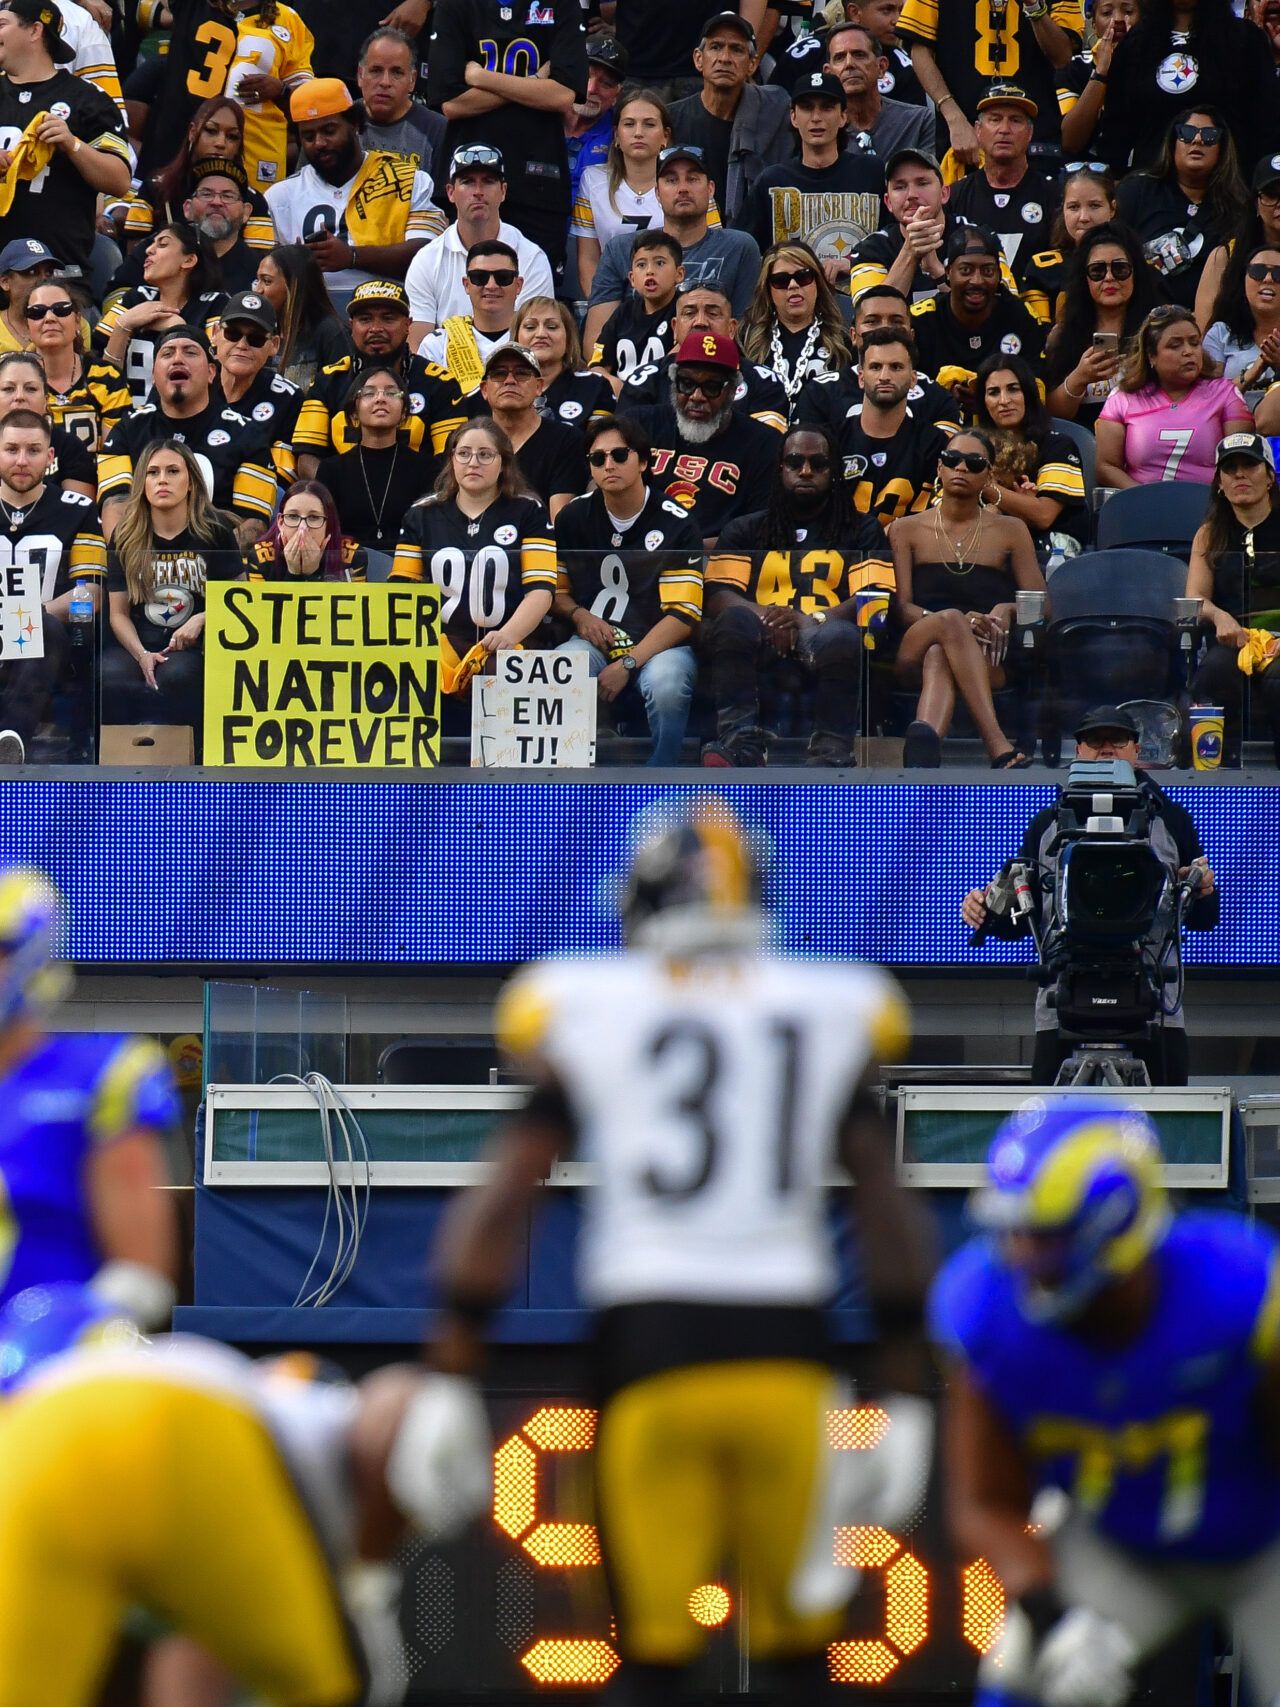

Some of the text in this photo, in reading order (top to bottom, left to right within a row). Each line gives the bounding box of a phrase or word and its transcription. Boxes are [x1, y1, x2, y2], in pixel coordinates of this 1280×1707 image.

[769, 186, 881, 244] PITTSBURGH
[431, 545, 509, 628] 90
[756, 550, 845, 615] 43
[218, 587, 439, 651] STEELER
[233, 659, 438, 717] NATION
[504, 655, 573, 688] SAC
[223, 714, 440, 766] FOREVER
[513, 697, 563, 726] EM
[516, 736, 559, 765] TJ!
[642, 1012, 815, 1202] 31
